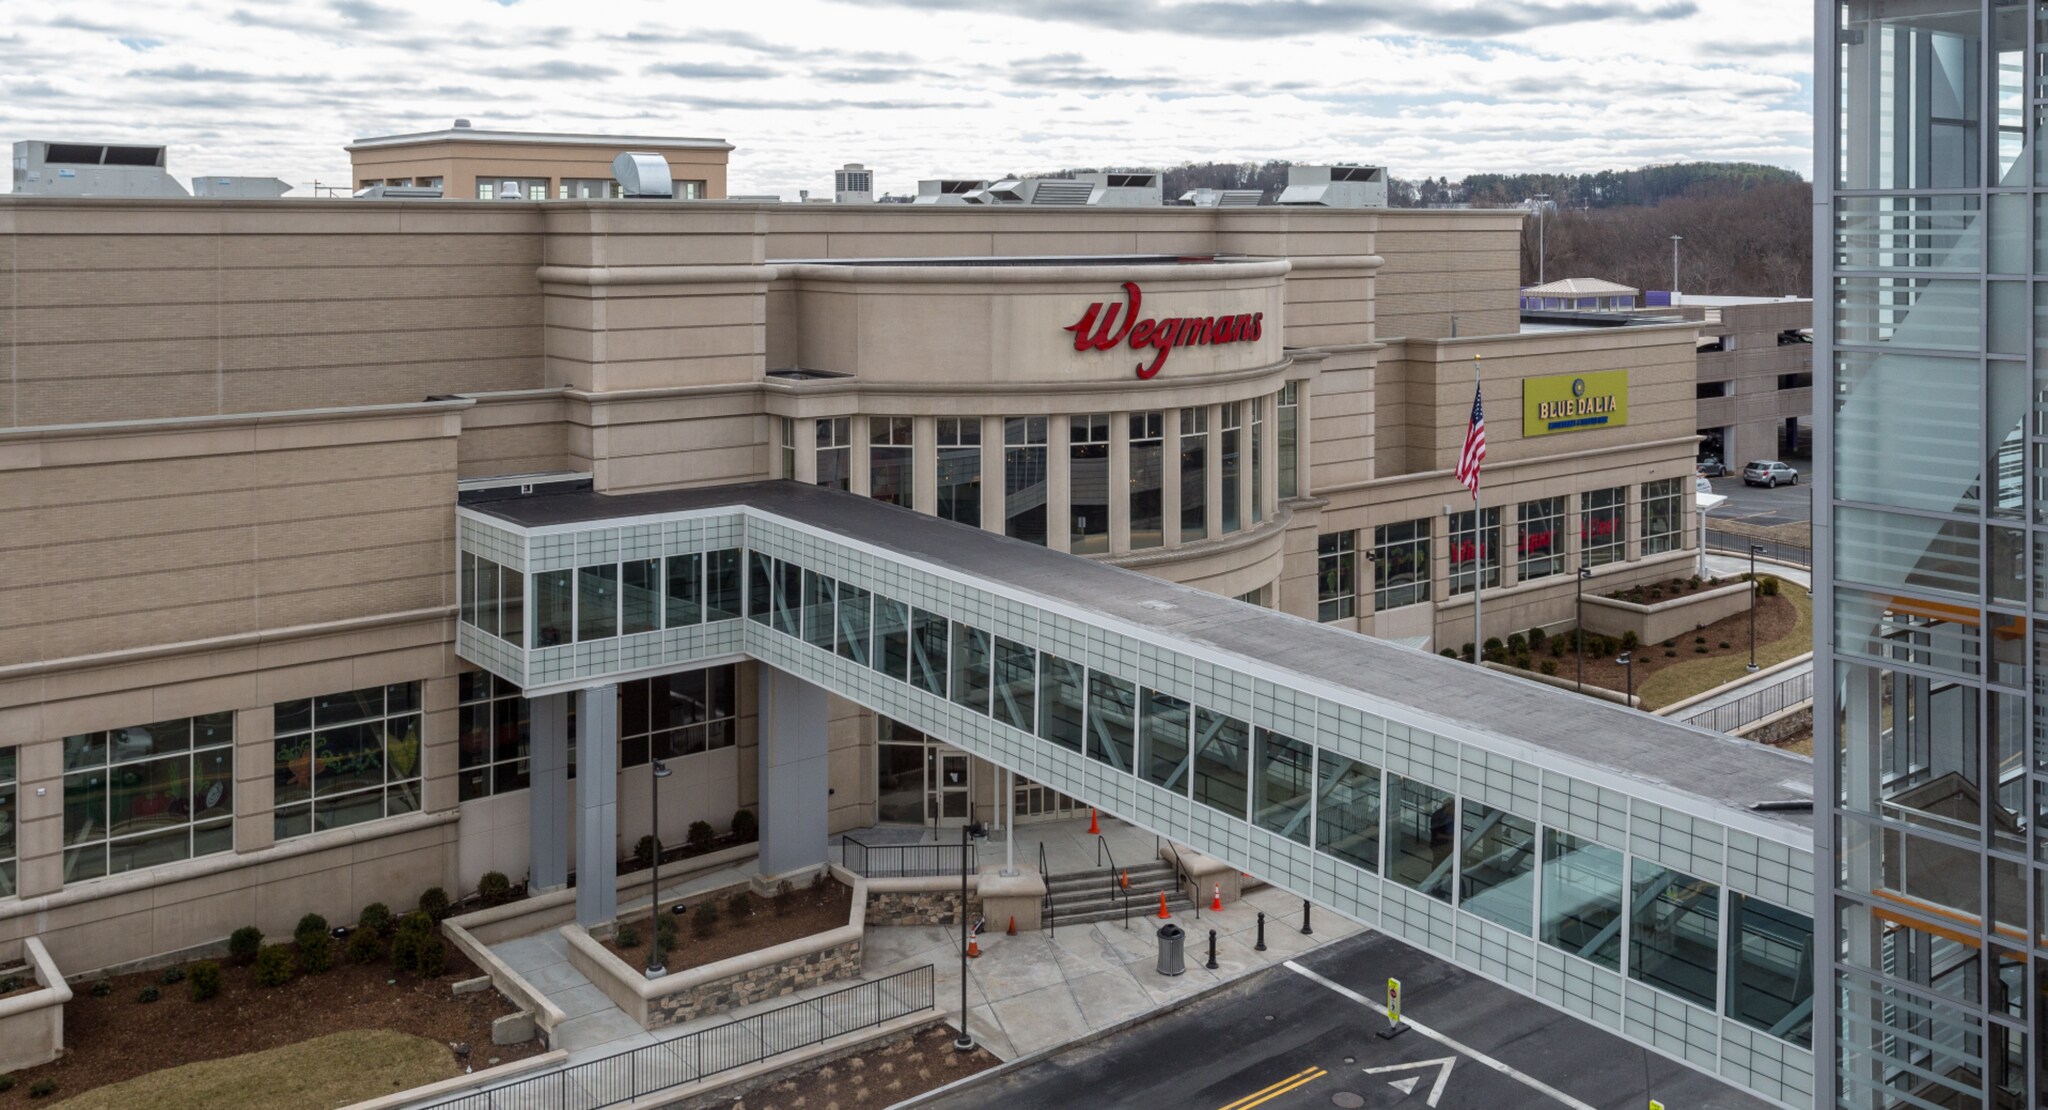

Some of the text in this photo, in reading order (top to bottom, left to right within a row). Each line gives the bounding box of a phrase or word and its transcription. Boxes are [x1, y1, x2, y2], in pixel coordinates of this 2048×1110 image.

[1063, 281, 1263, 380] Wegmans
[1539, 395, 1617, 419] BLUE DALIA
